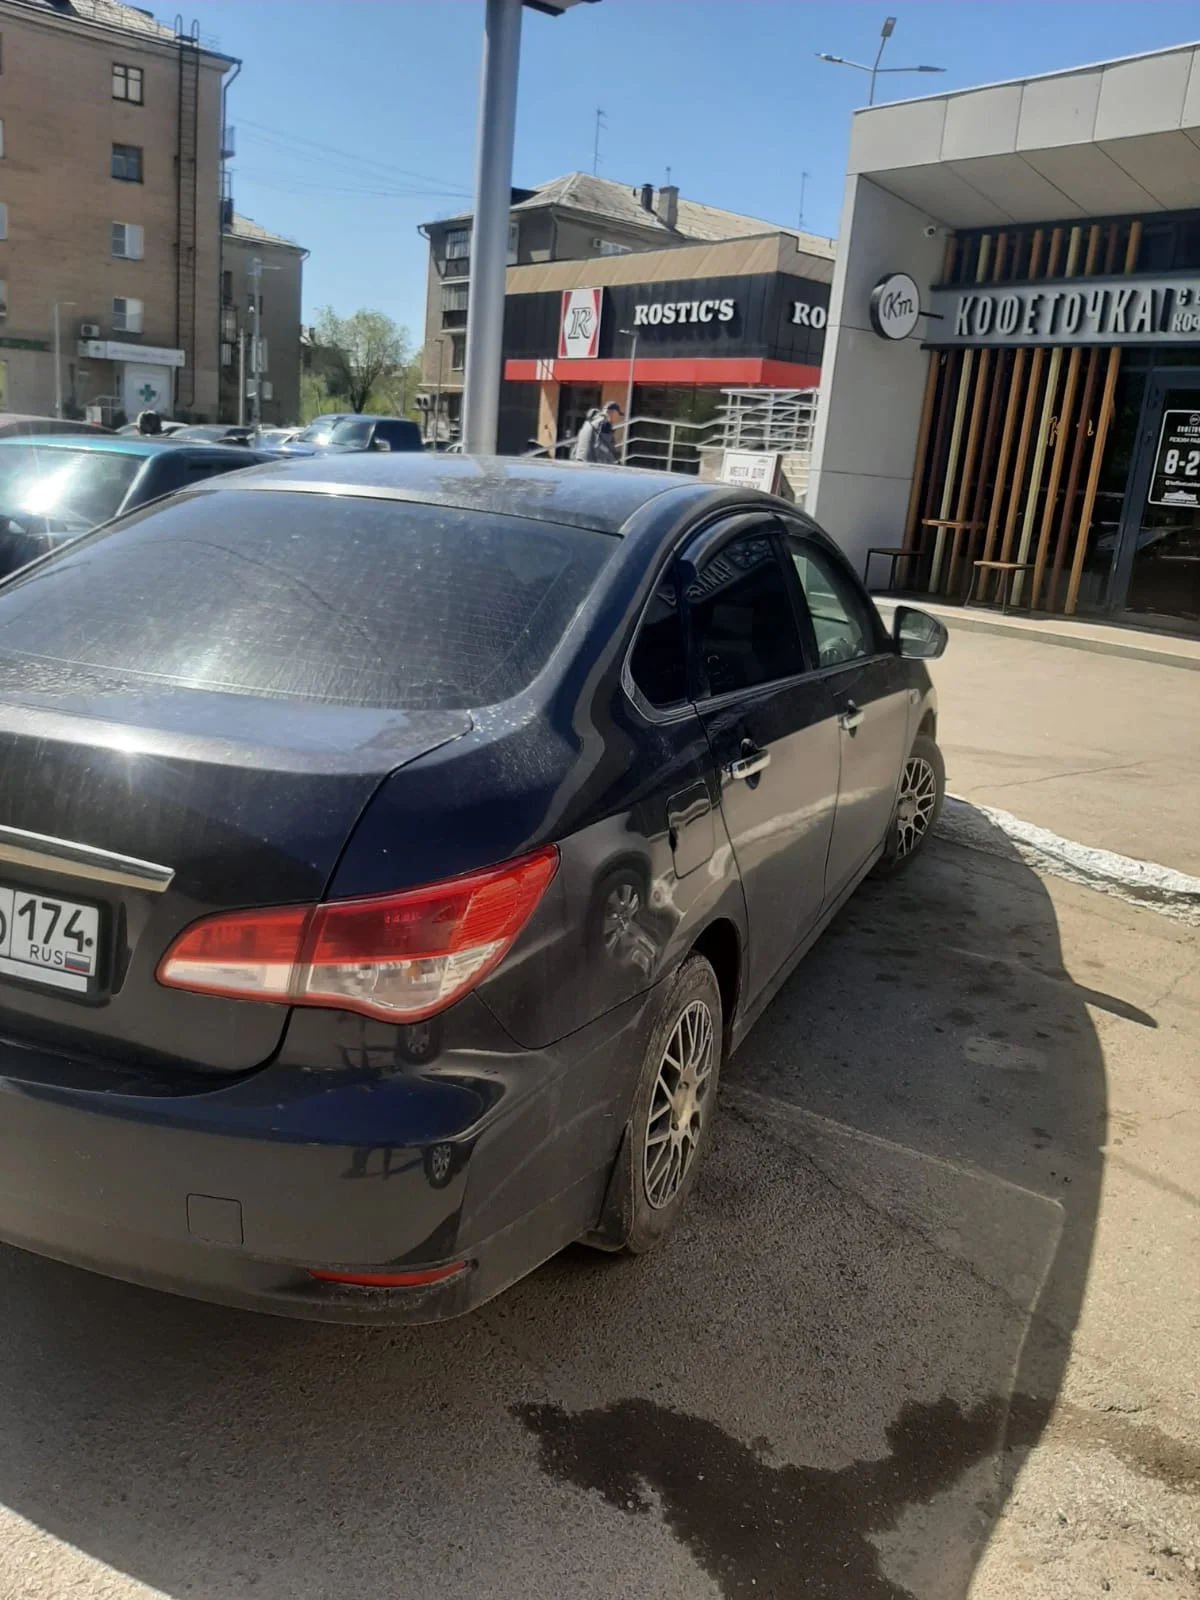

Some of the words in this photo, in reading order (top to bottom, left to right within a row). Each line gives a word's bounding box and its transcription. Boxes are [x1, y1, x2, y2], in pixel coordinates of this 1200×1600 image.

[568, 307, 592, 340] R
[633, 299, 734, 326] ROSTIC'S
[955, 288, 1152, 336] КОФЕТОЧКА
[18, 899, 85, 952] 174
[29, 944, 64, 965] RUS
